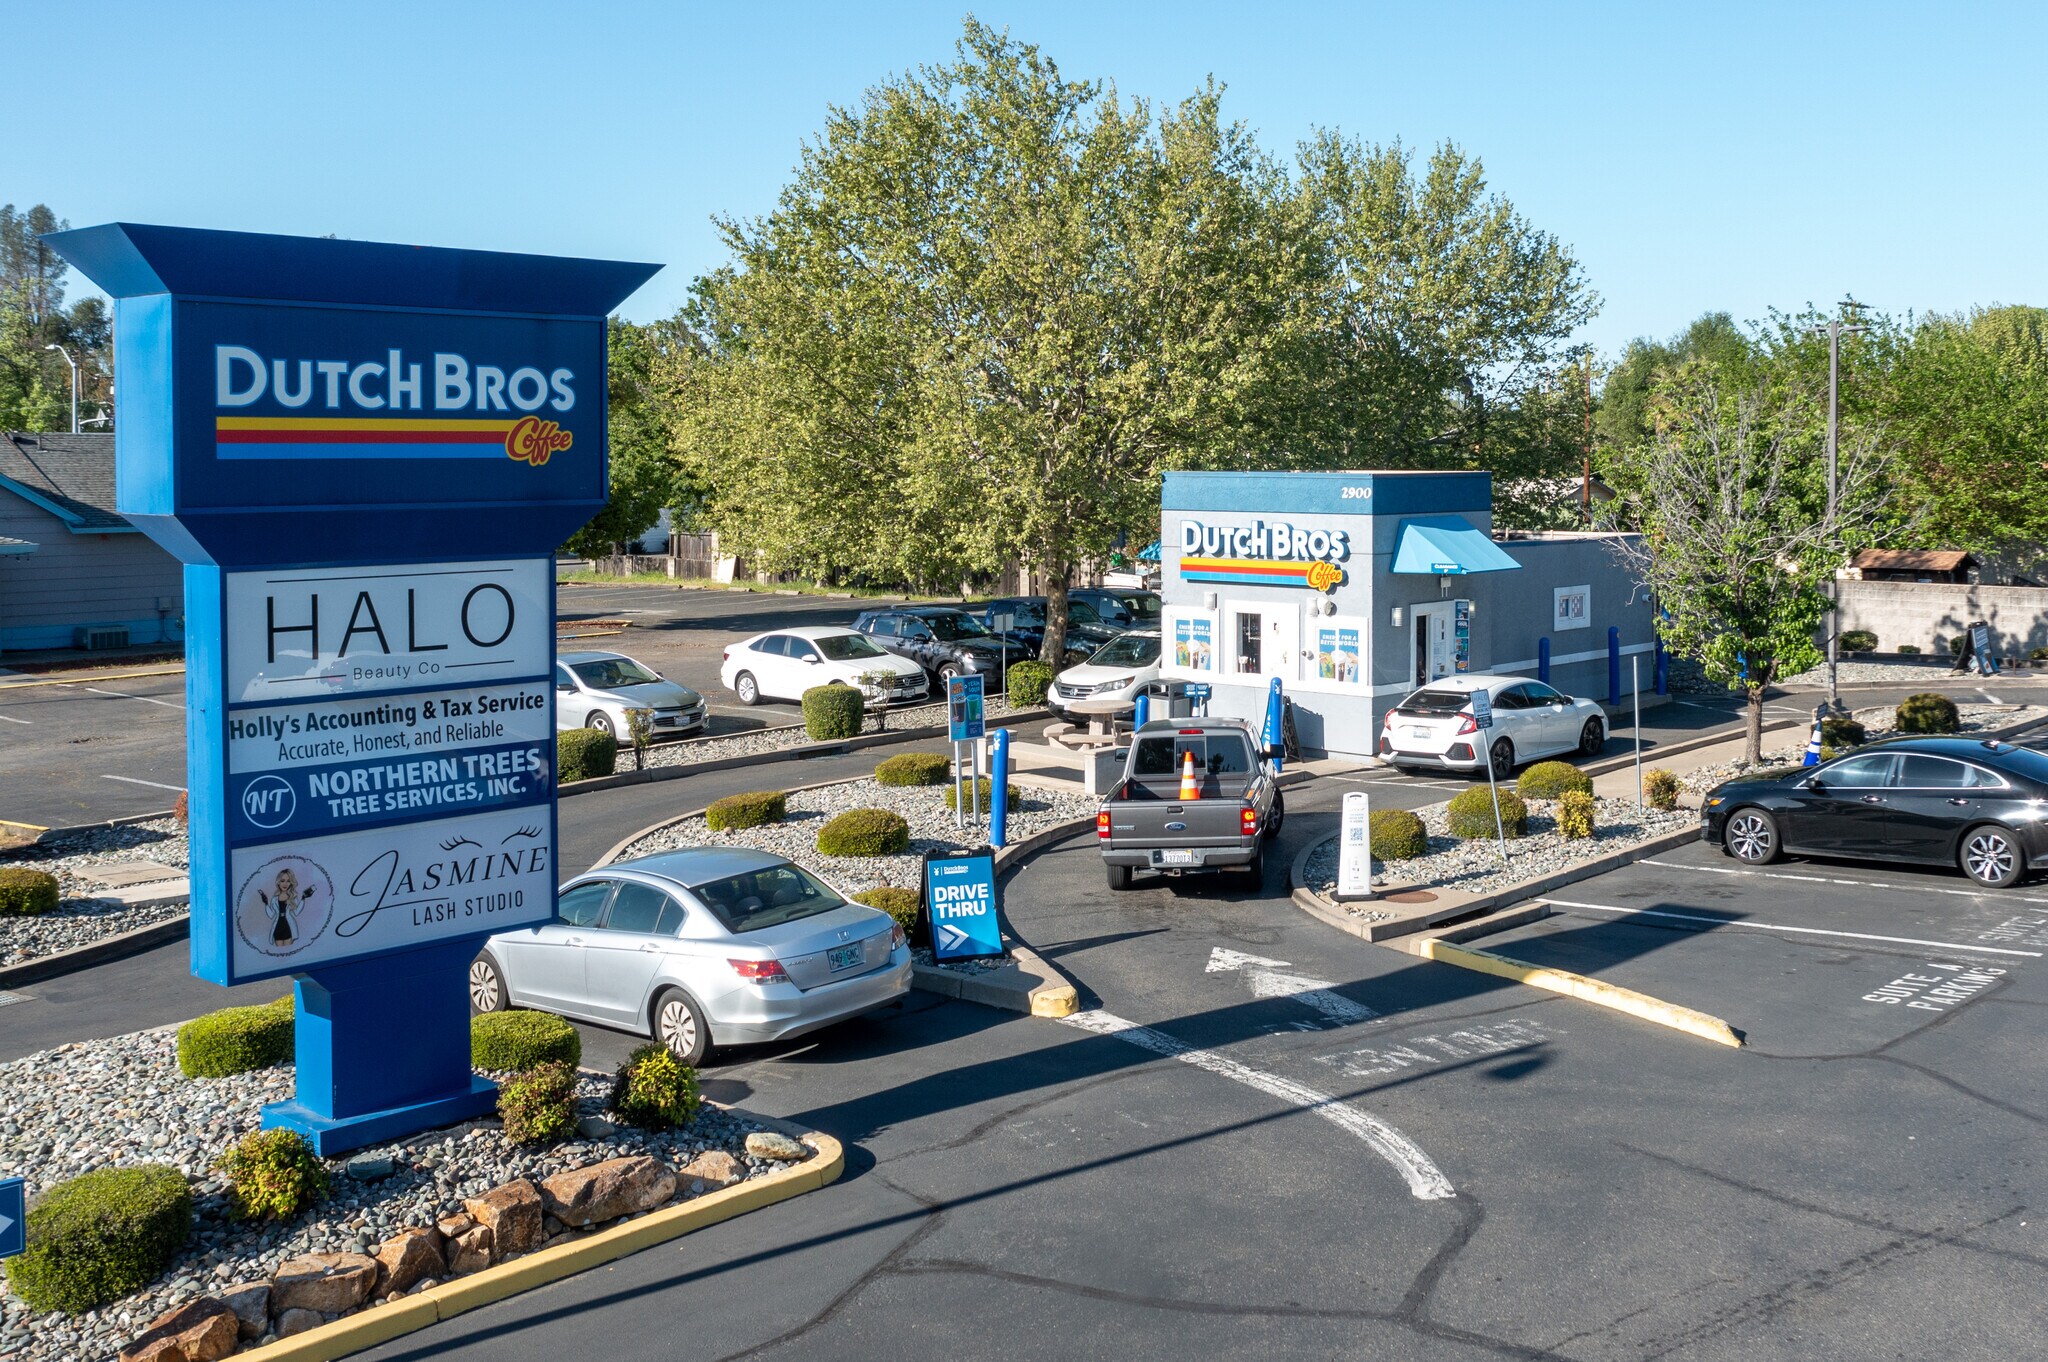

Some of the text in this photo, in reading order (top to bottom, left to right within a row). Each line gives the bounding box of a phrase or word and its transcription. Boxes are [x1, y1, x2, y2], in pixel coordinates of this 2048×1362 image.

[434, 352, 576, 411] BROS
[506, 416, 572, 465] Coffee
[1341, 486, 1372, 499] 2900
[1272, 522, 1347, 559] BROS
[1307, 561, 1342, 591] Coffee
[266, 583, 515, 663] HALO
[353, 661, 441, 680] Beauty Co
[230, 691, 544, 741] Holly's Accounting & Tax Service
[278, 720, 504, 762] Accurate, Honest, and Reliable
[309, 748, 541, 798] NORTHERN TREES
[246, 788, 290, 815] NT
[328, 776, 527, 818] TREE SERVICES, INC.
[335, 846, 548, 938] JASMINE
[413, 890, 523, 926] LASH STUDIO
[934, 883, 989, 902] DRIVE
[935, 900, 986, 919] THRU
[830, 947, 859, 965] 949 GNC
[1862, 963, 1965, 1005] SUITE A
[1906, 967, 2007, 1012] PARKING
